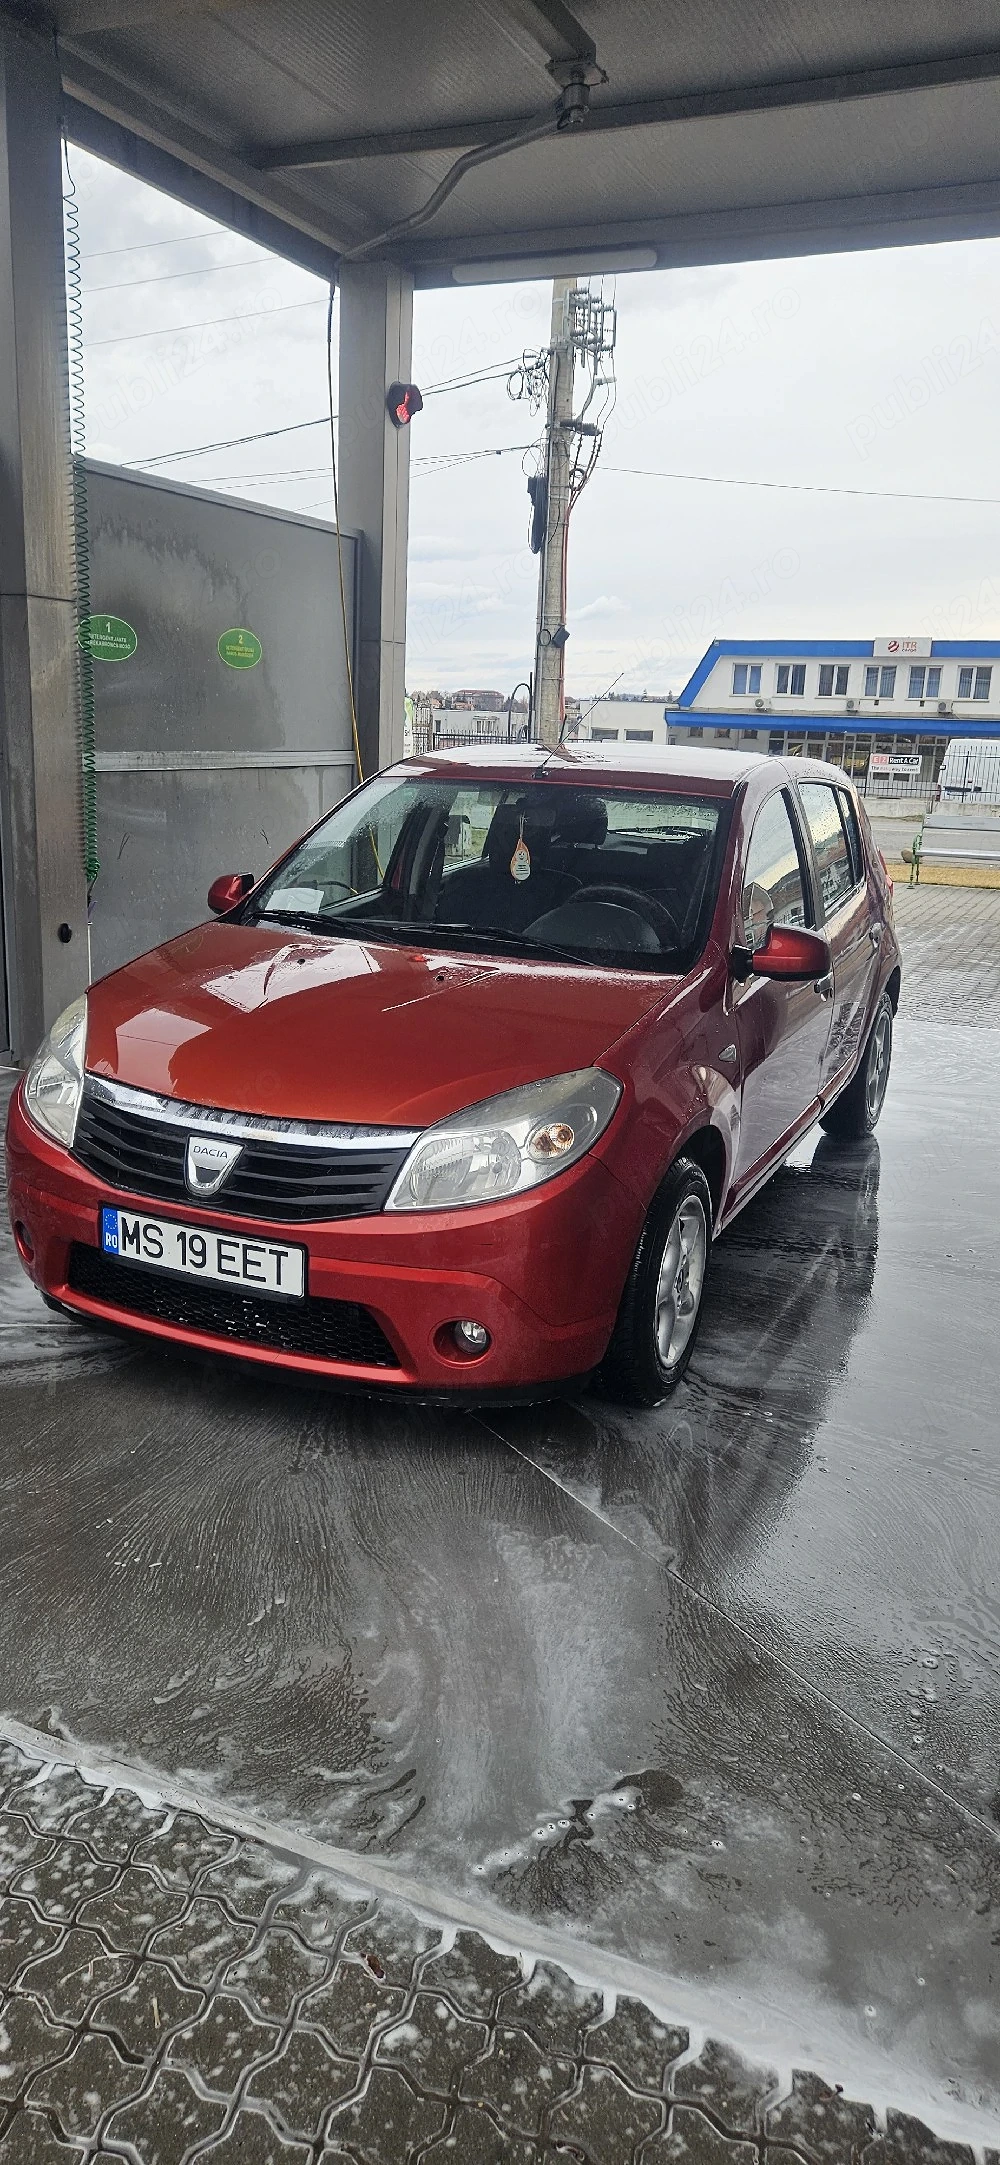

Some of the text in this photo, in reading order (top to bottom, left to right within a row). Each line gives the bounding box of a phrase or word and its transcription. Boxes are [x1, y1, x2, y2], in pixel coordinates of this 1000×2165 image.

[105, 621, 111, 633] 1
[238, 634, 243, 644] 2
[902, 641, 918, 649] ITR
[192, 1144, 228, 1159] DACIA
[105, 1232, 118, 1248] RO
[121, 1216, 290, 1286] MS 19 EET
